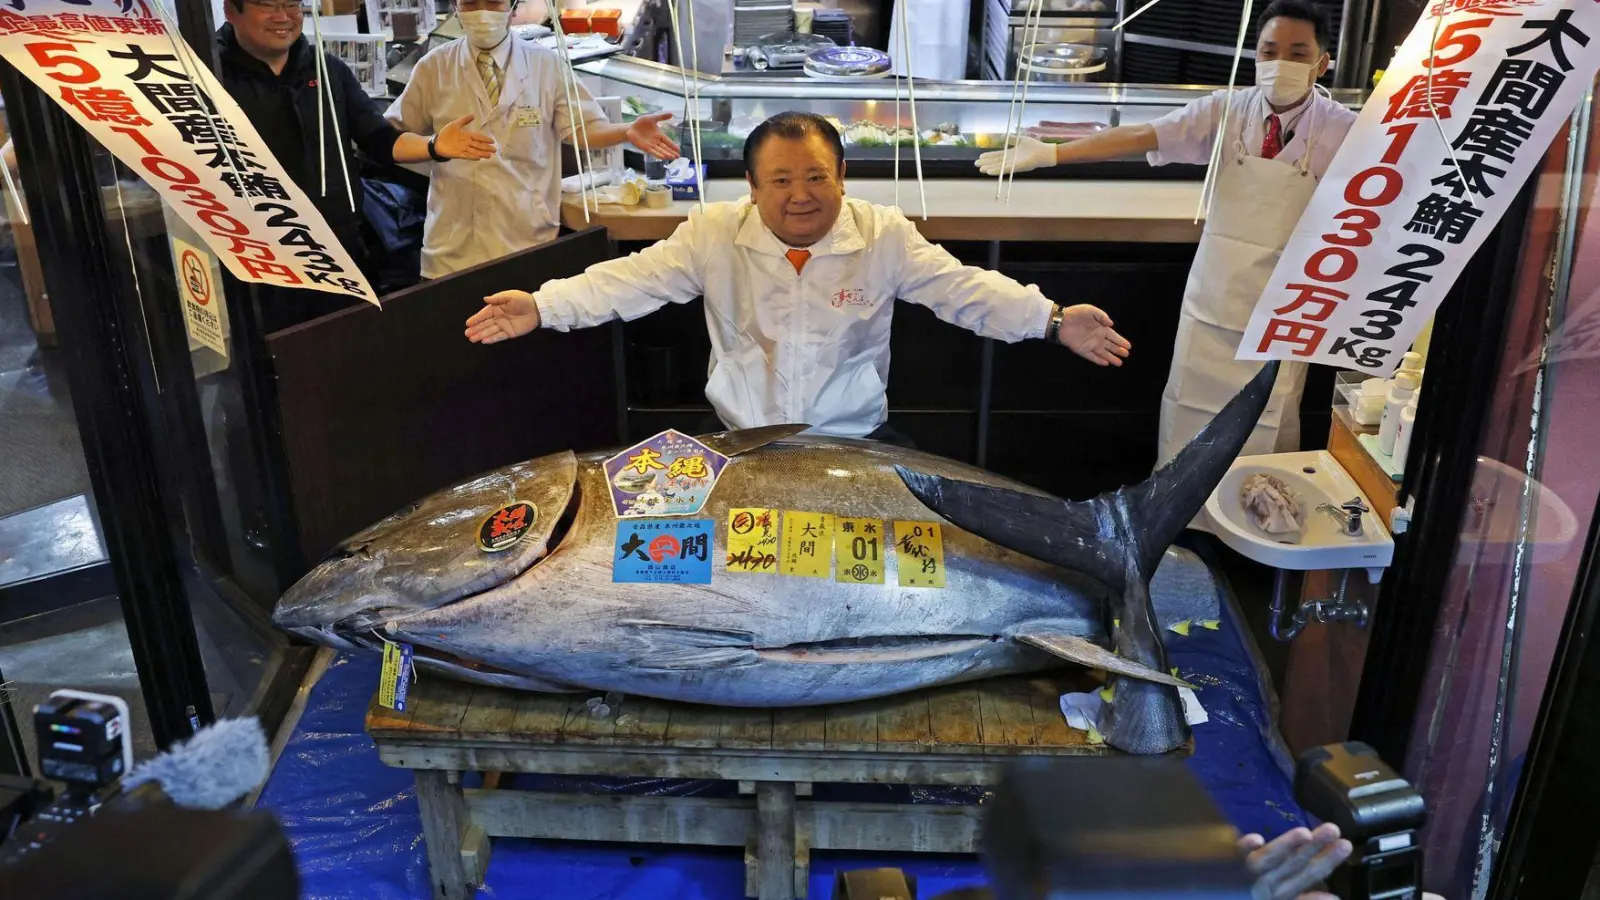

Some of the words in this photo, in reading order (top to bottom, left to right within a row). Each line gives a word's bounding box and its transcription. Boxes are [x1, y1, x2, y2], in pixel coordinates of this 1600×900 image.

[0, 12, 168, 35] 上最高値更新
[24, 43, 303, 285] 5億1030万円
[1256, 17, 1493, 357] 5億1030万円
[800, 522, 818, 557] 大間
[913, 525, 934, 538] 01
[852, 536, 878, 561] 01
